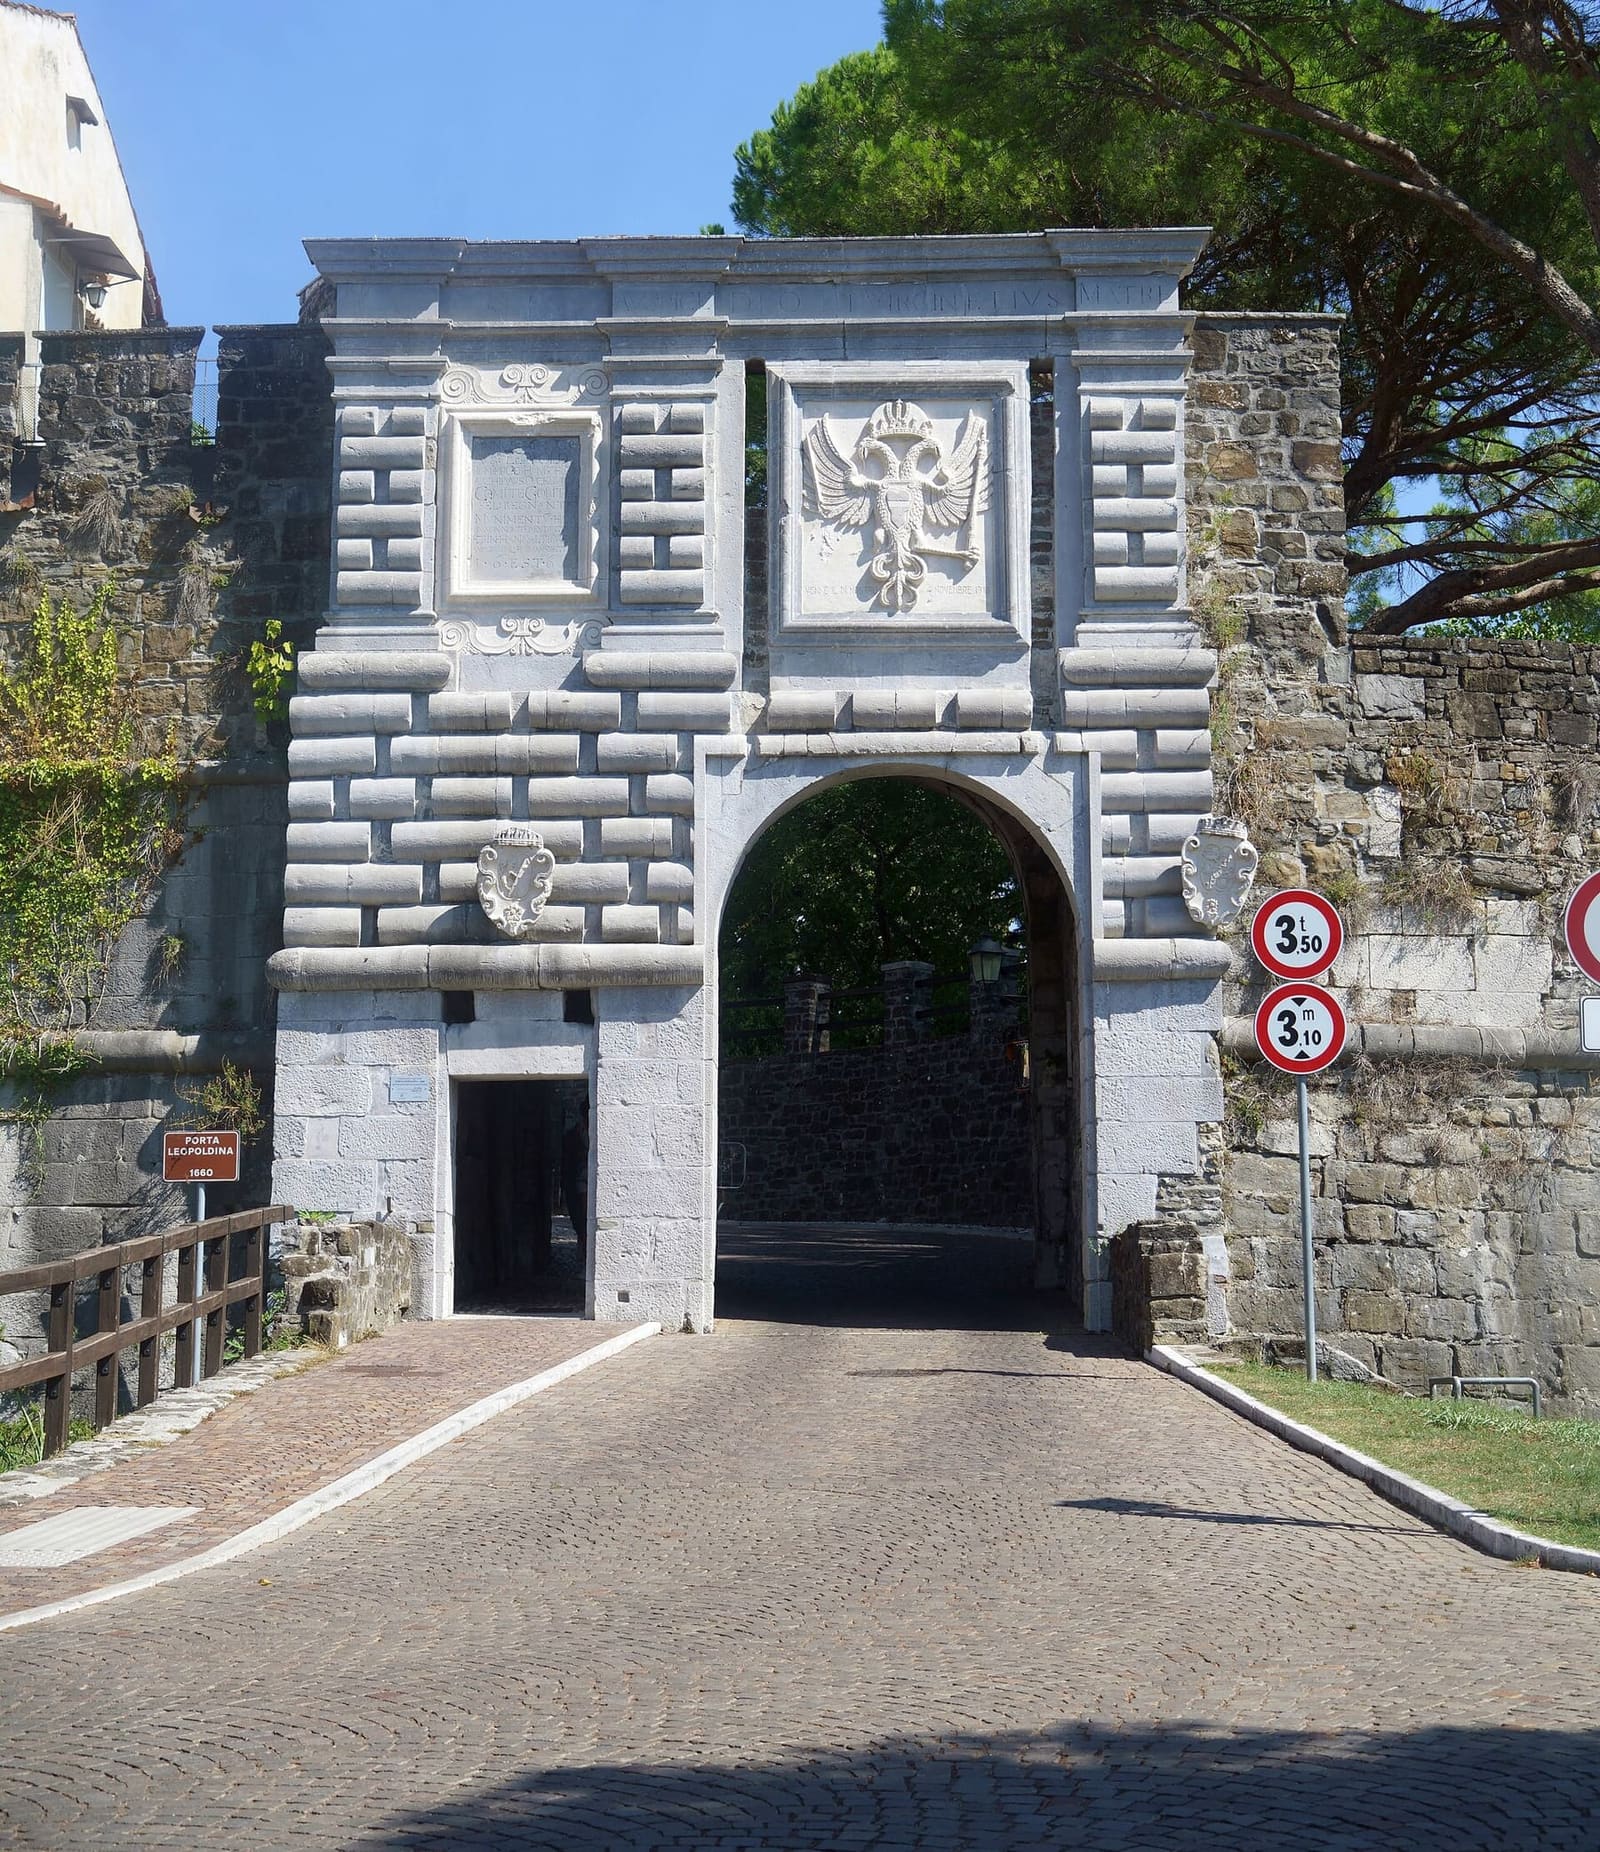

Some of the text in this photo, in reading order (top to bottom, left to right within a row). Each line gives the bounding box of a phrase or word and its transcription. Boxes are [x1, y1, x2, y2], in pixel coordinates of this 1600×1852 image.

[1299, 916, 1306, 931] t
[1303, 1010, 1314, 1020] m
[185, 1136, 219, 1144] PORTA
[168, 1147, 233, 1155] LEOPOLDINA
[190, 1168, 213, 1176] 1660
